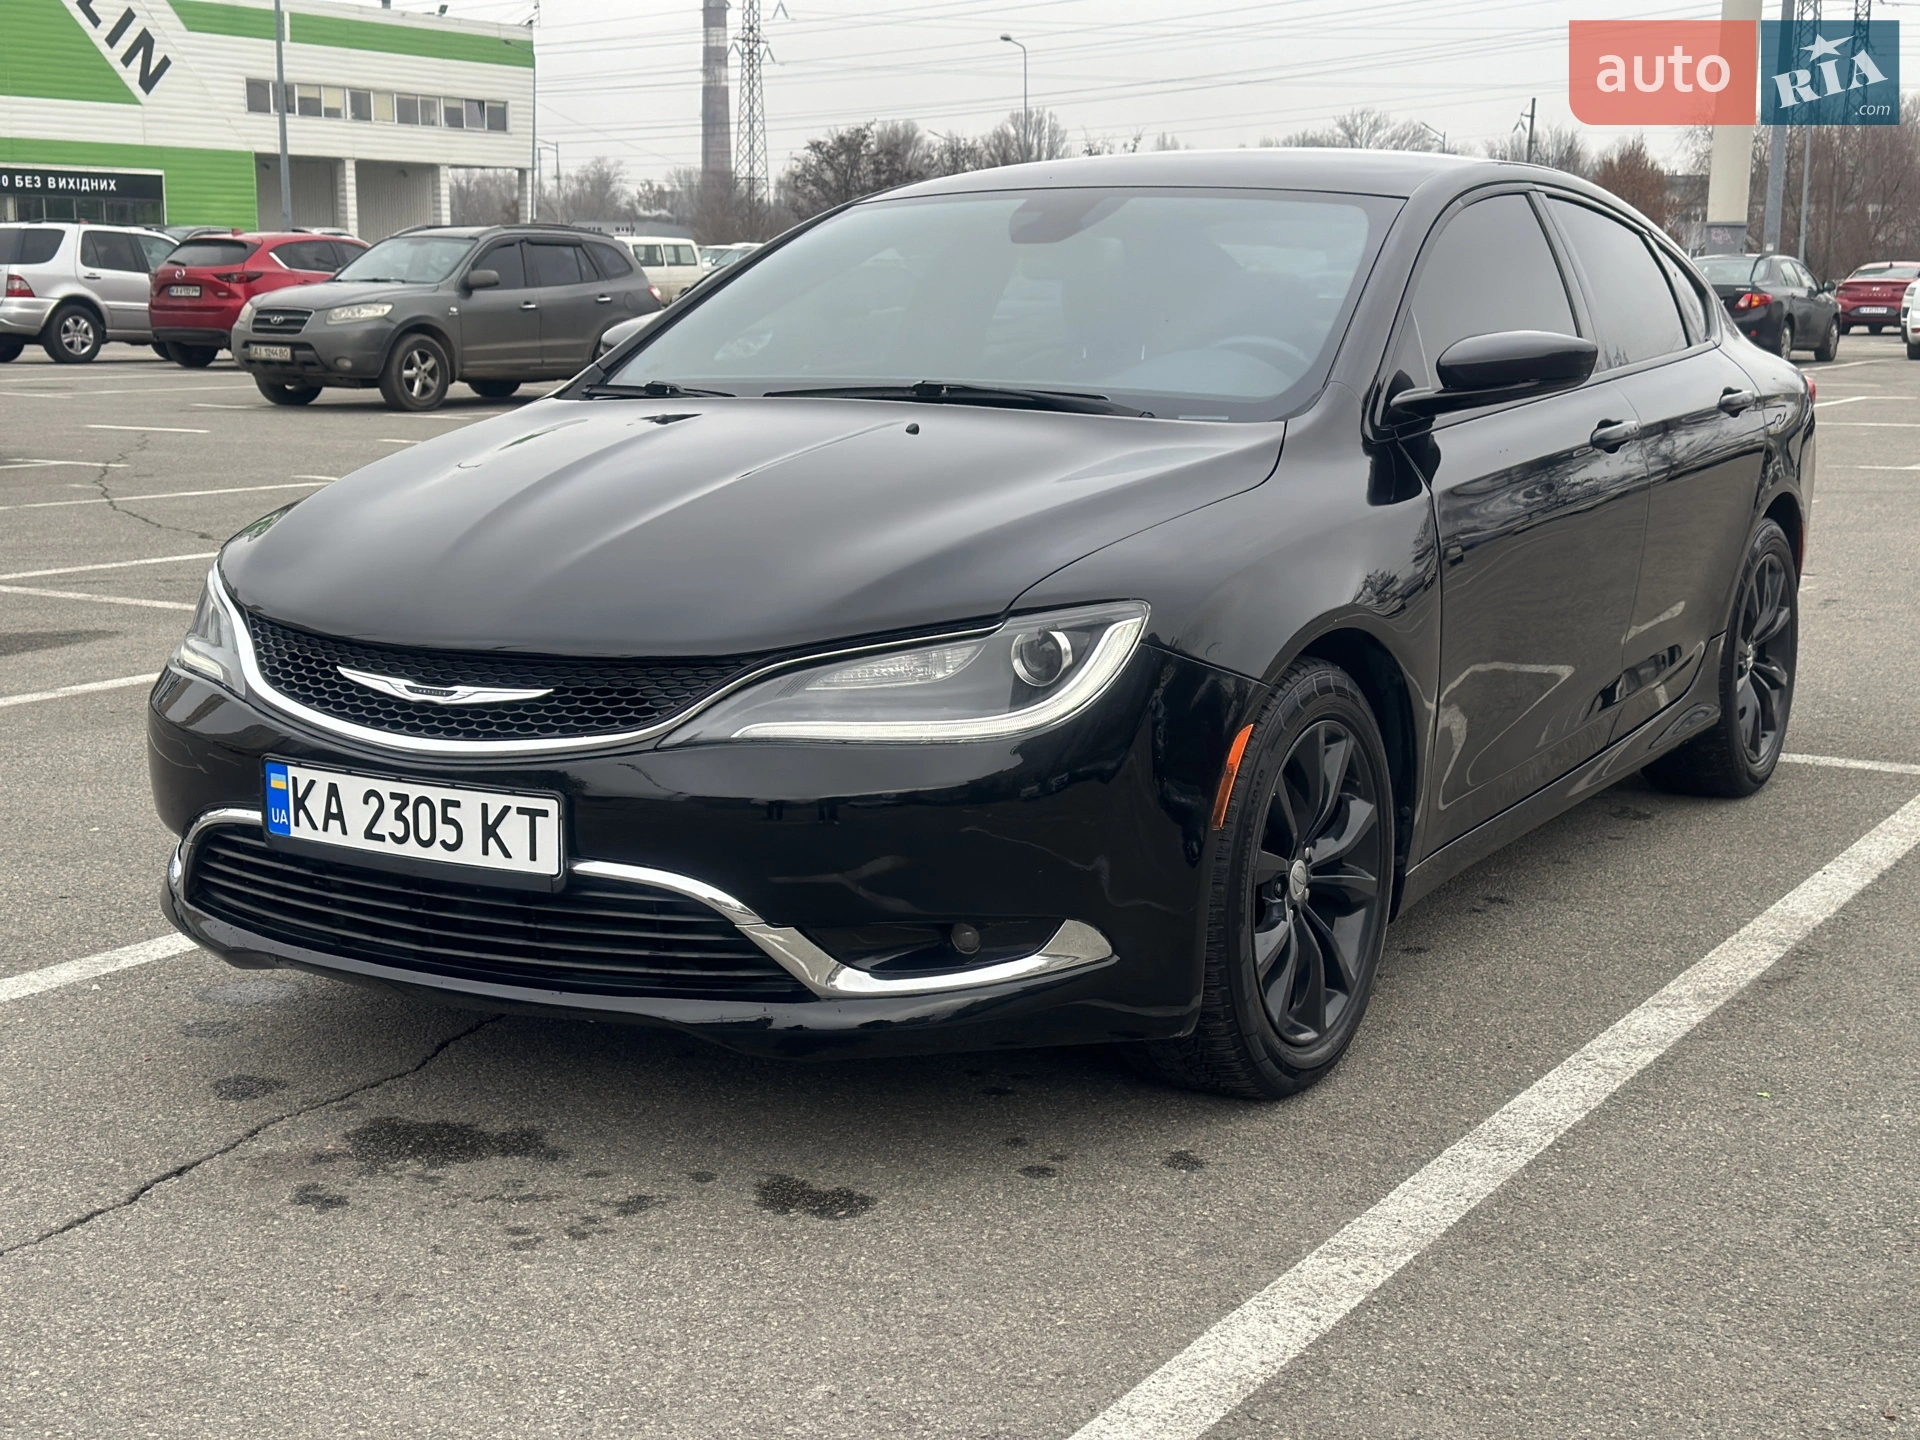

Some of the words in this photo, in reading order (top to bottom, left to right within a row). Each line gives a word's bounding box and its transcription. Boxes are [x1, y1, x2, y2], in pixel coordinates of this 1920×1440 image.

[15, 175, 42, 188] БЕЗ
[48, 177, 117, 192] ВИХІДНИХ
[271, 808, 288, 826] UA
[291, 776, 348, 836] KA
[362, 788, 463, 852] 2305
[481, 802, 549, 862] KT
